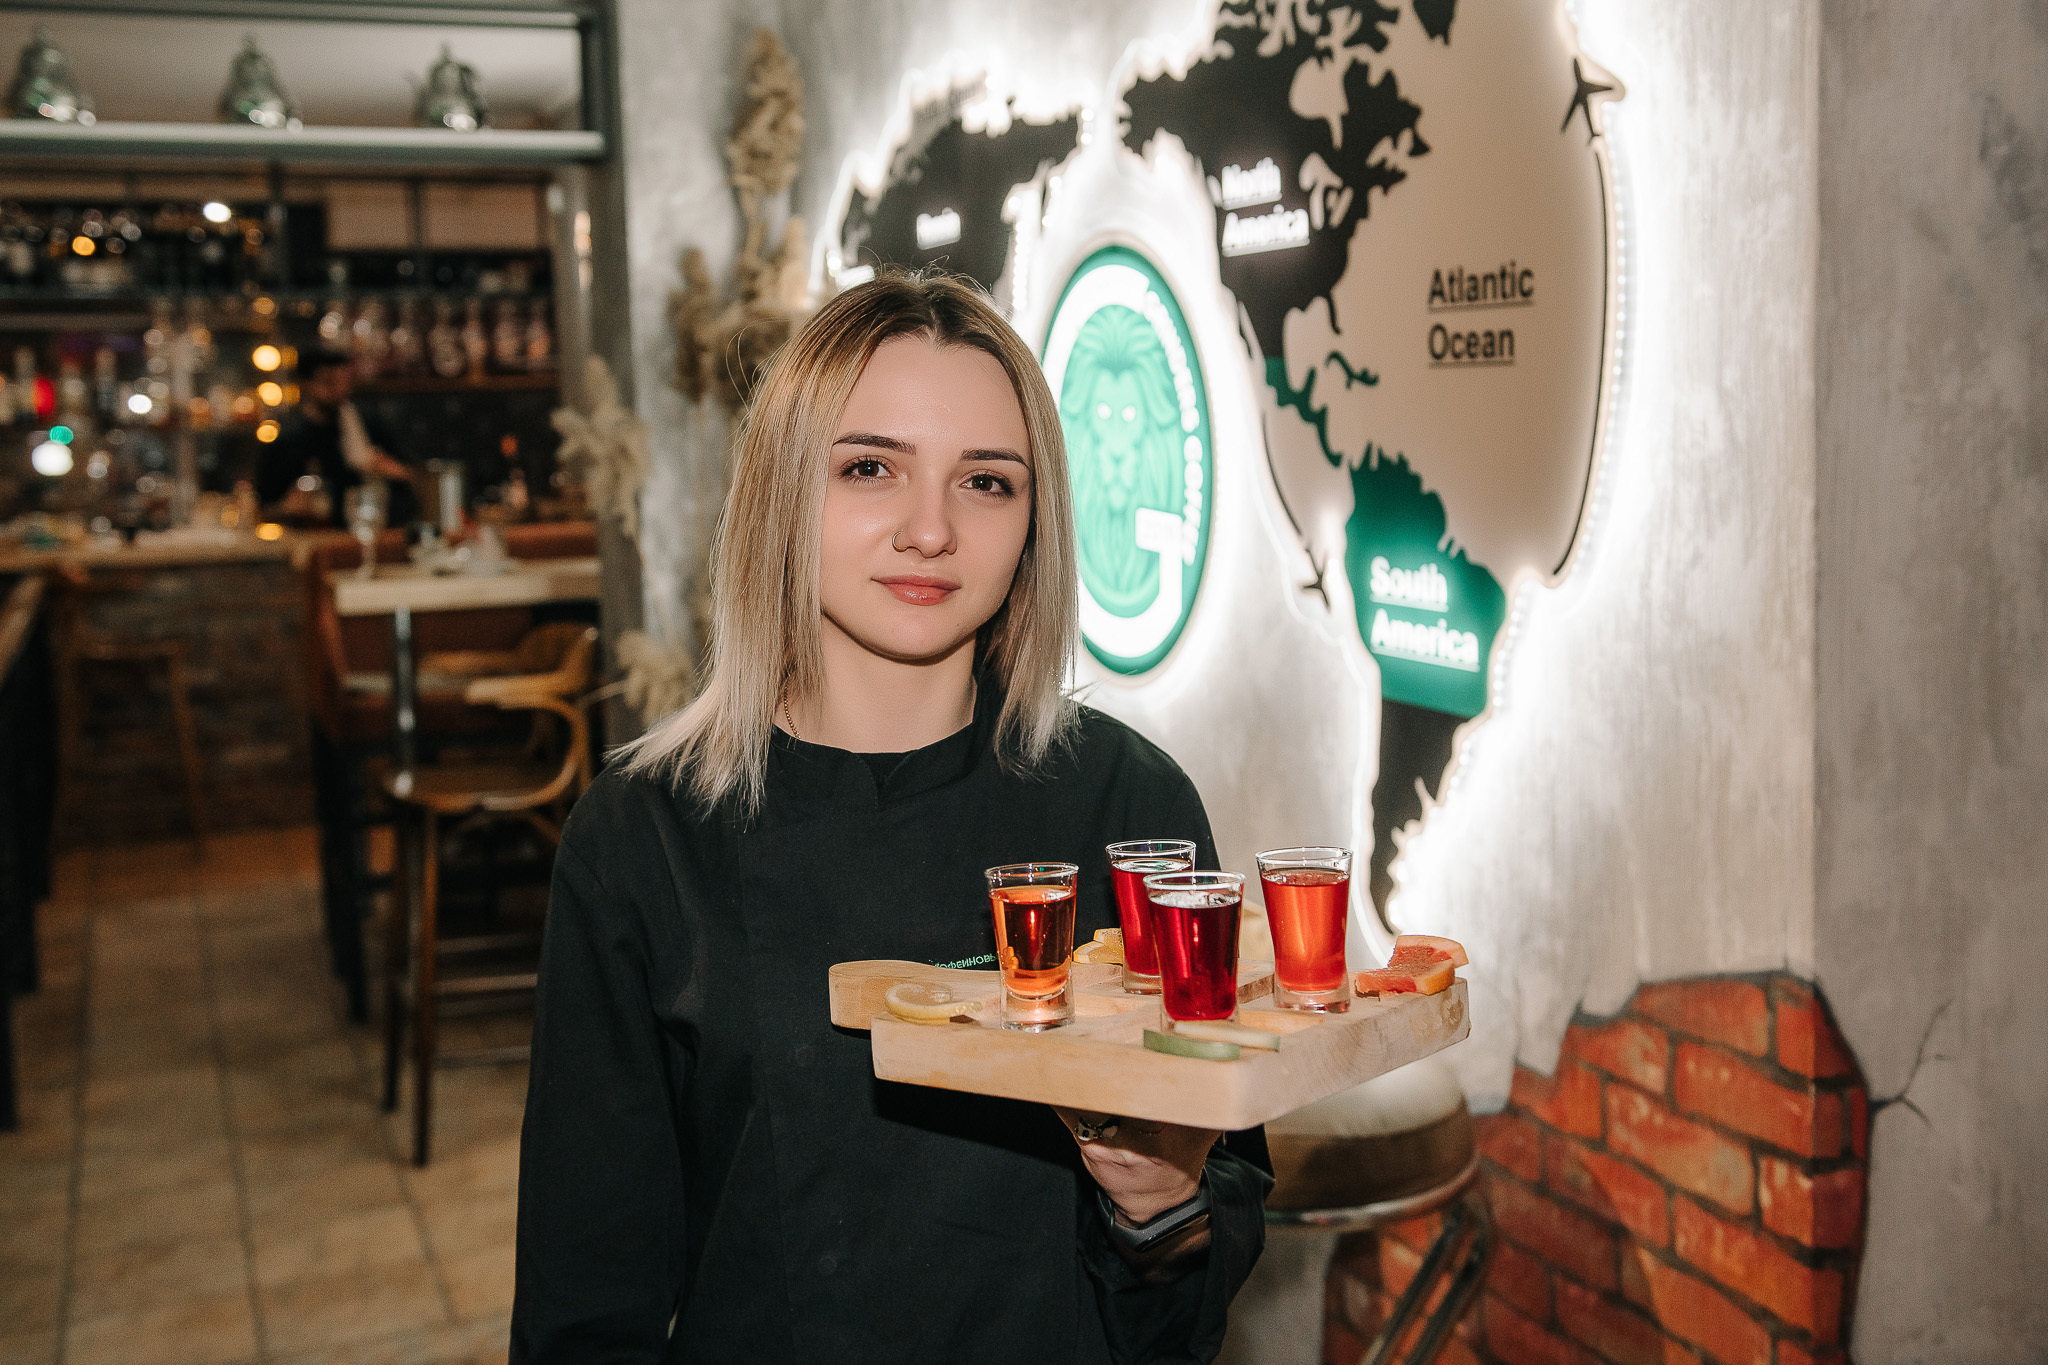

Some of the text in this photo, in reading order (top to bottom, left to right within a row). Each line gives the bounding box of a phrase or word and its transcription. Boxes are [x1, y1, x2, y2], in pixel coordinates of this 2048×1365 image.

[1222, 204, 1310, 251] America
[1429, 259, 1535, 306] Atlantic
[1429, 323, 1515, 363] Ocean
[1370, 556, 1448, 606] South
[1370, 608, 1480, 666] America
